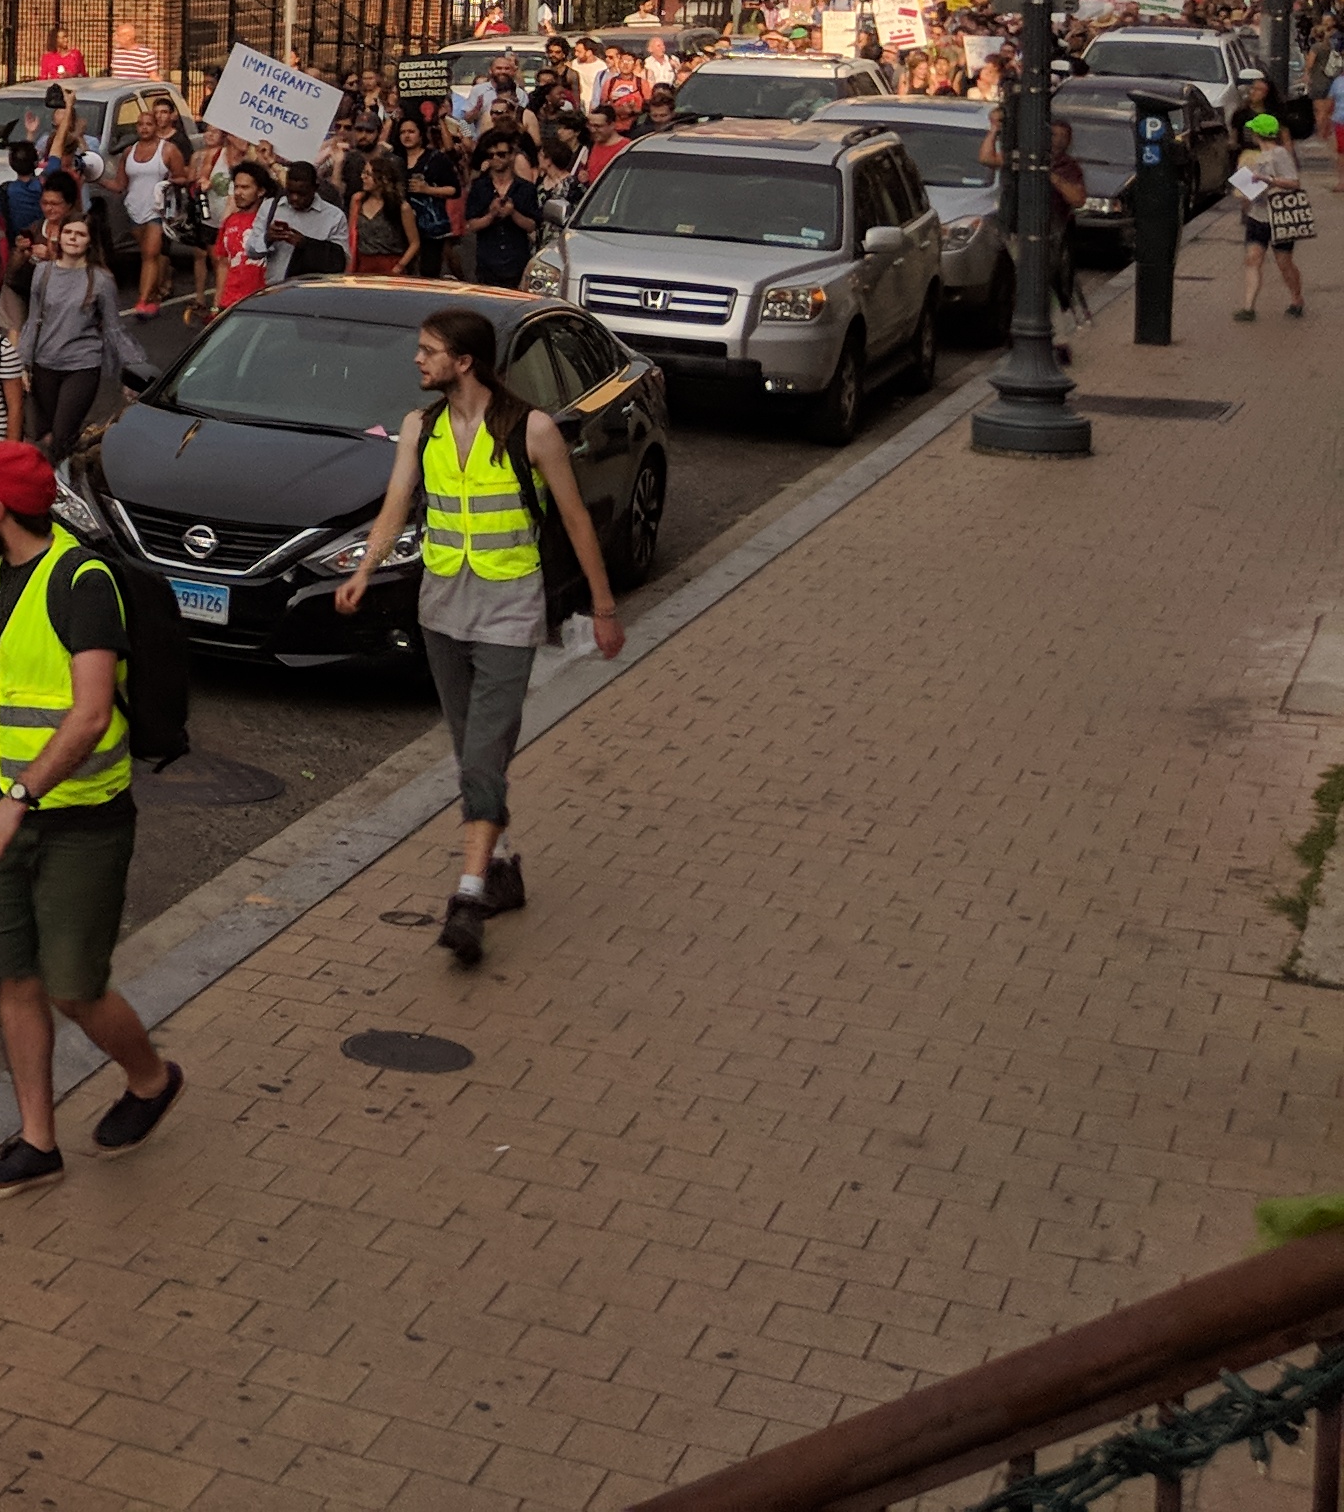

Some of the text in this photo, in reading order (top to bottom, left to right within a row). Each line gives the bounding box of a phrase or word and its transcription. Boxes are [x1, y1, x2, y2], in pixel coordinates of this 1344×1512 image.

[241, 54, 322, 99] IMMIGRANTS
[398, 78, 448, 89] O ESPERA
[259, 83, 287, 104] ARE
[239, 90, 310, 130] DREAMERS
[249, 115, 274, 135] TOO
[1145, 117, 1162, 139] P
[1271, 192, 1308, 209] GOD
[1273, 208, 1313, 225] HATES
